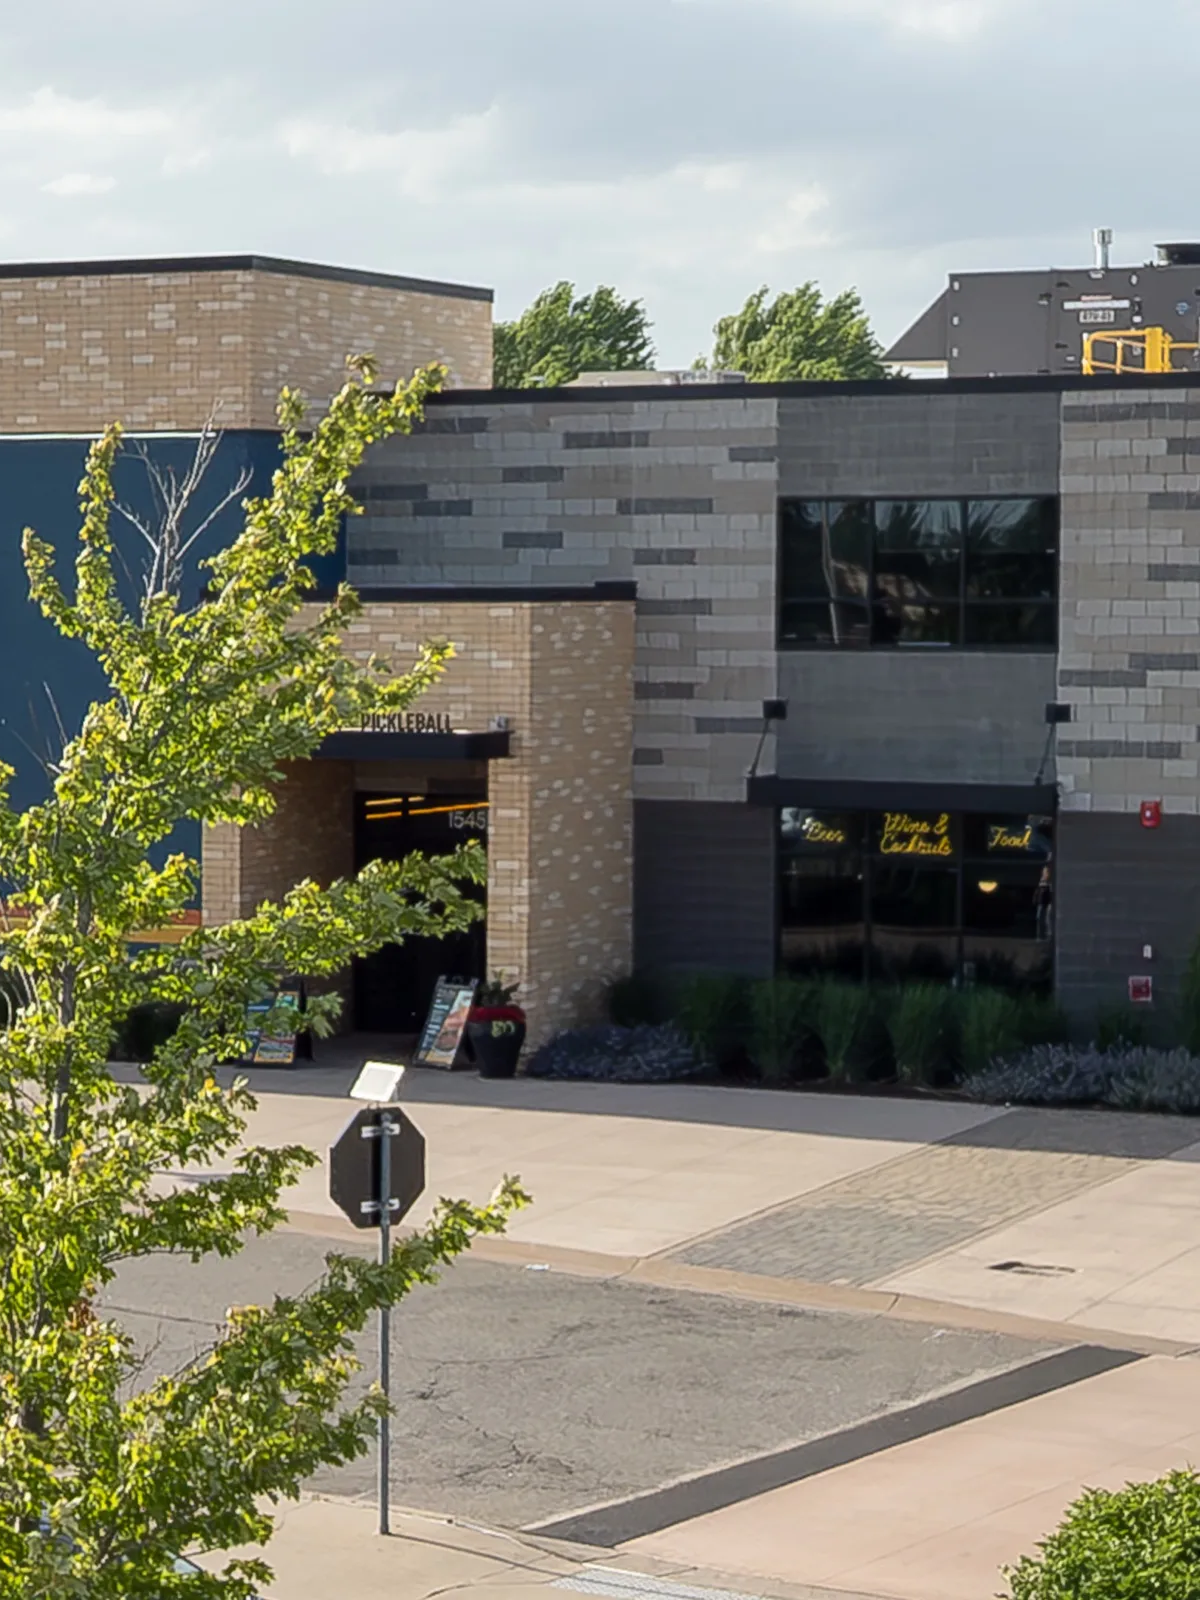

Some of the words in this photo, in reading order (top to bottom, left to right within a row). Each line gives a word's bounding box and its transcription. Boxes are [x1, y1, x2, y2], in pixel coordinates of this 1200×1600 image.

[360, 711, 453, 733] PICKLEBALL
[448, 810, 486, 830] 1545
[884, 812, 930, 833] Wine
[933, 812, 949, 835] &
[880, 832, 952, 856] Cocktails
[990, 825, 1031, 848] Food
